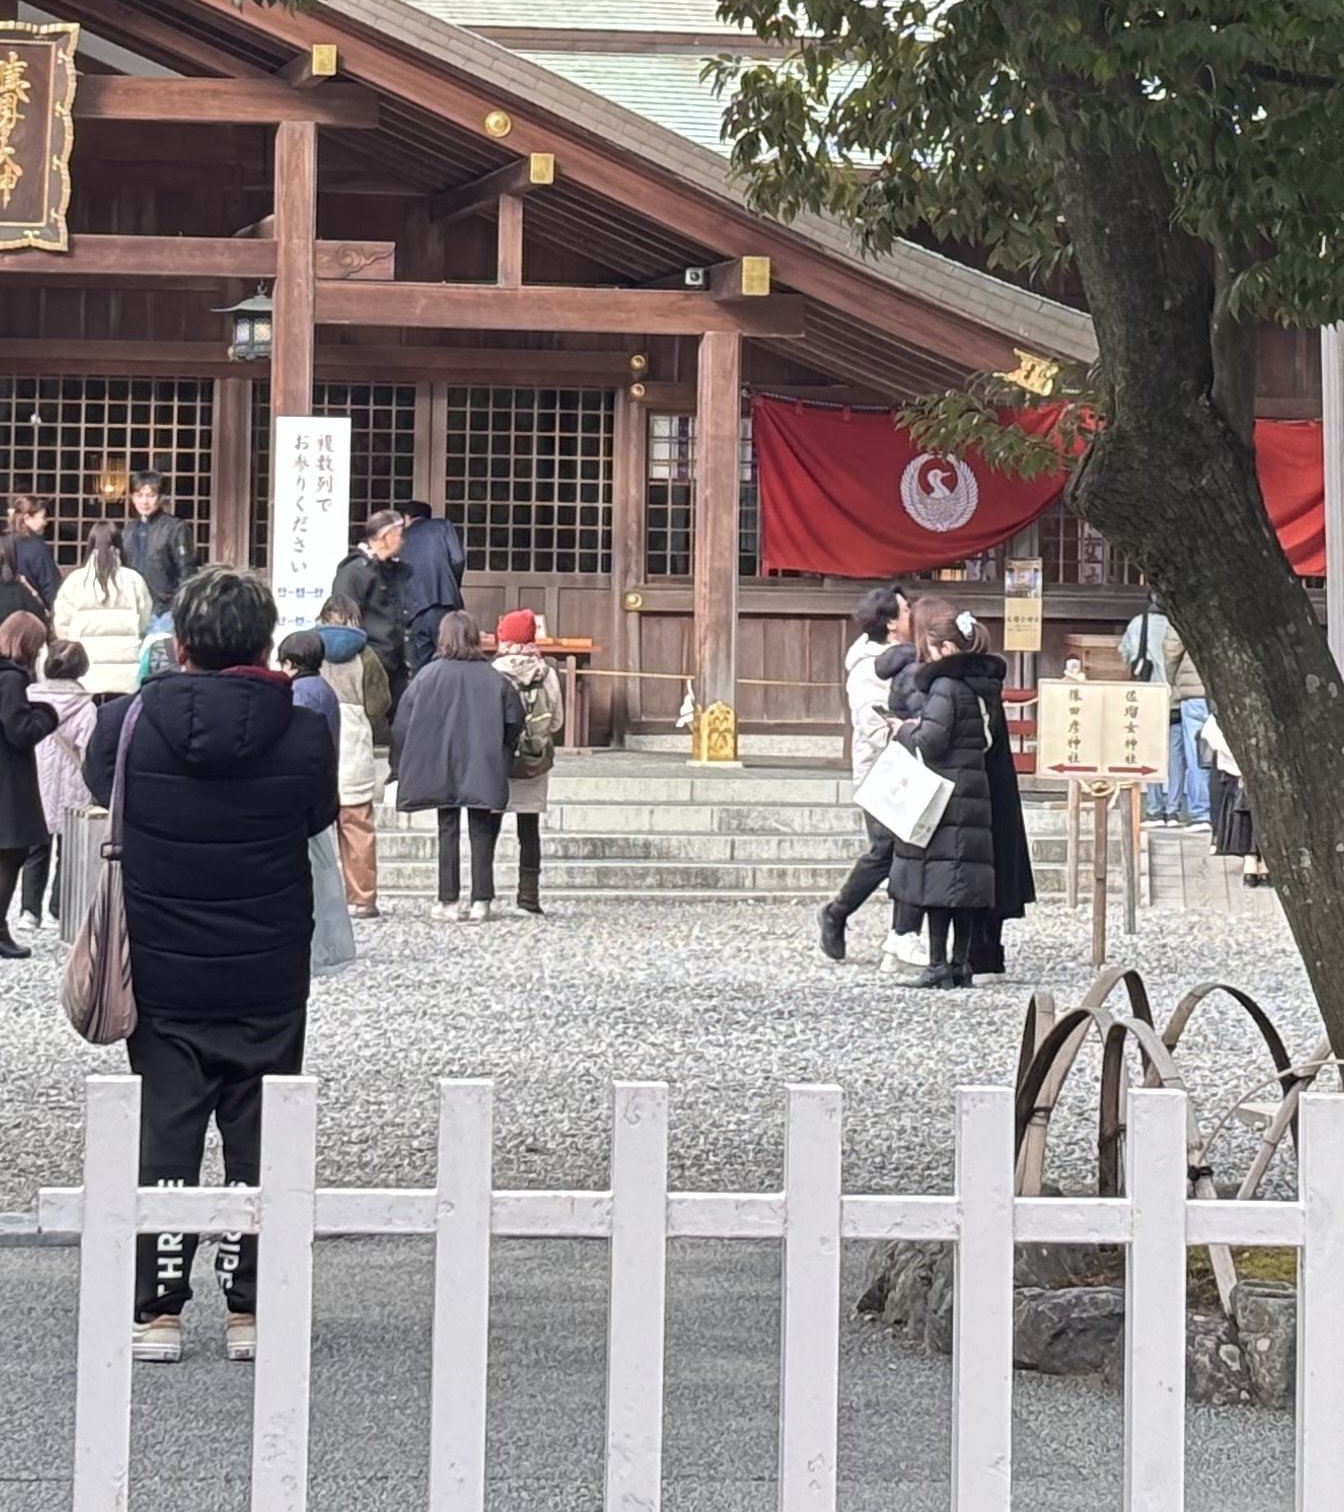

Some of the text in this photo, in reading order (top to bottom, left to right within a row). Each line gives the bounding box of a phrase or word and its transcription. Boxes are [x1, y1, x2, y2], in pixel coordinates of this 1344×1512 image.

[292, 434, 309, 573] お参りください
[315, 434, 334, 512] 複数列で
